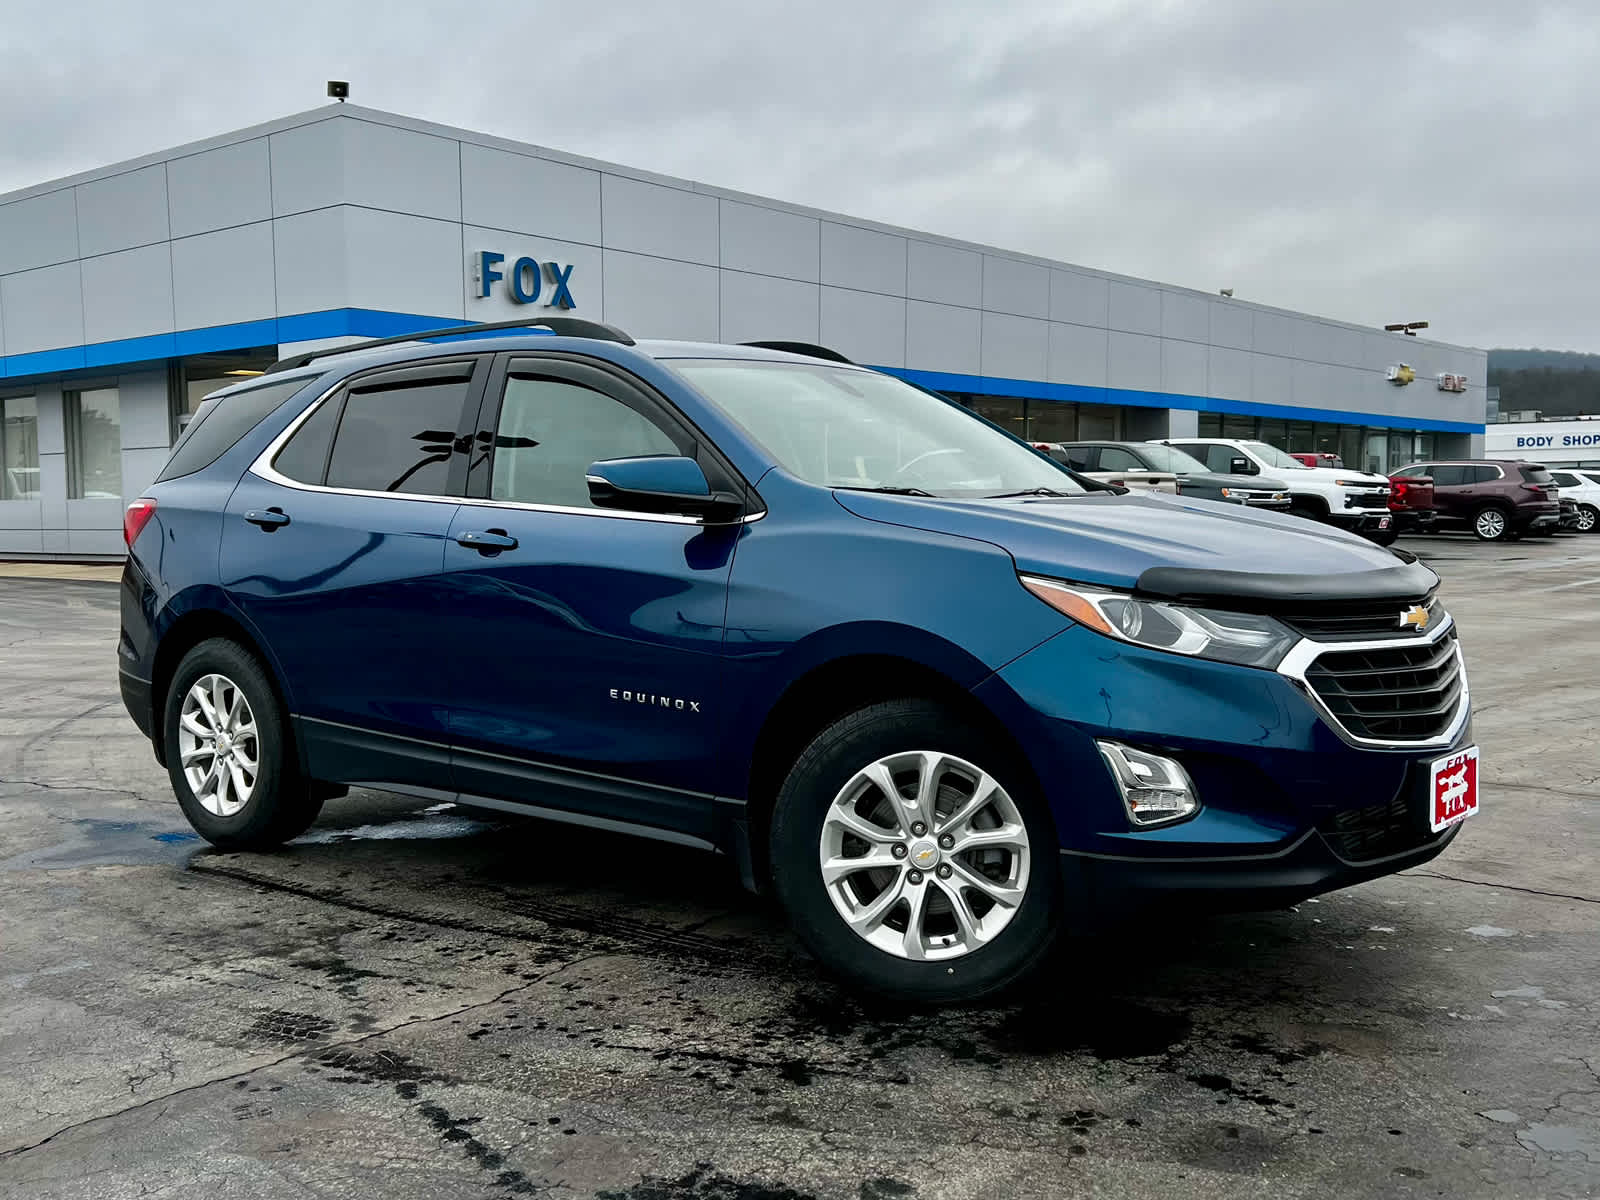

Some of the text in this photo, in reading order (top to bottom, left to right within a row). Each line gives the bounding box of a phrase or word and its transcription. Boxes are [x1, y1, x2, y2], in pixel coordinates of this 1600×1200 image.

[476, 251, 577, 309] FOX
[1516, 434, 1600, 448] BODY SHOP
[609, 688, 700, 713] EQUINOX
